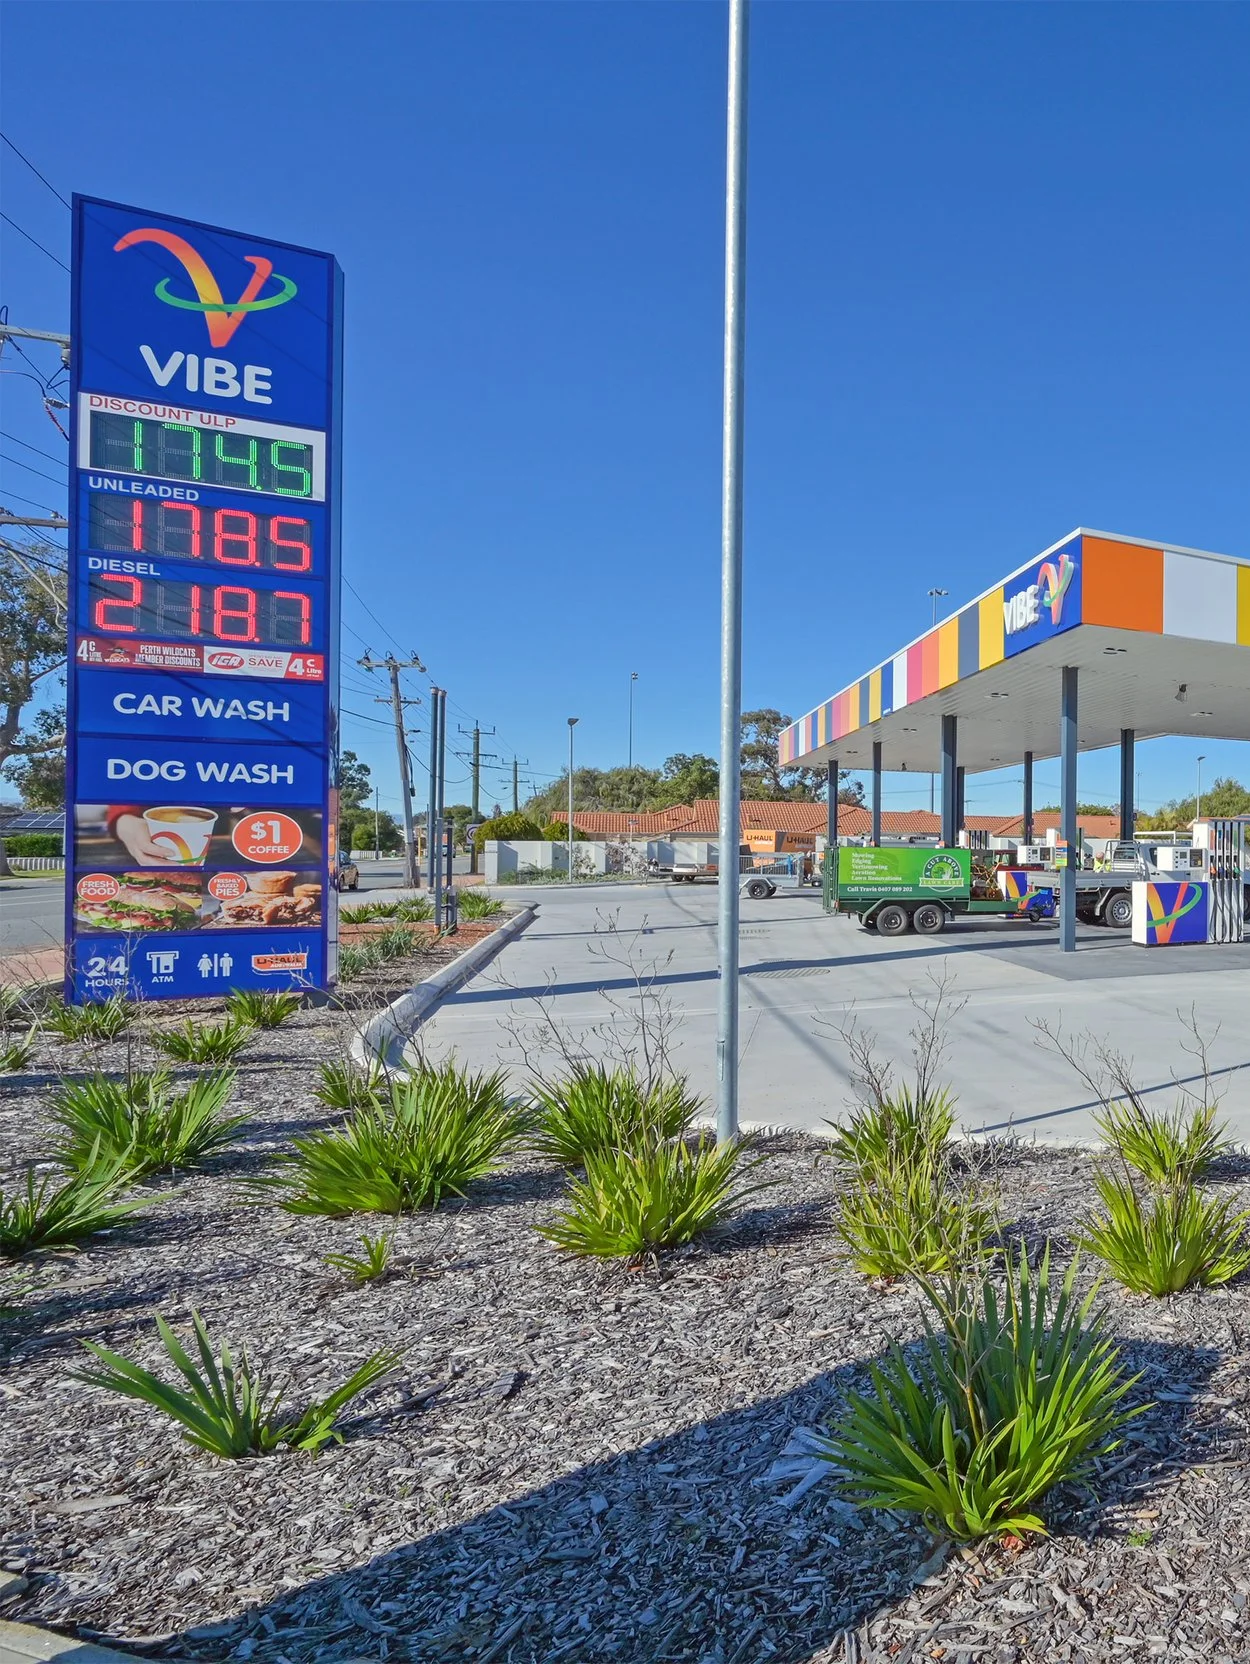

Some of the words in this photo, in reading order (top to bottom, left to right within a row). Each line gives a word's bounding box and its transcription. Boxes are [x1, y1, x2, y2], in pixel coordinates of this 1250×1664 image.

[139, 344, 273, 405] VIBE
[89, 395, 193, 423] DISCOUNT
[200, 411, 237, 429] ULP
[88, 476, 200, 502] UNLEADED
[88, 557, 161, 576] DIESEL
[1003, 584, 1039, 635] VIBE
[77, 640, 88, 662] 4
[135, 653, 164, 664] MEMBER
[165, 656, 201, 667] DISCOUNTS
[140, 645, 161, 655] PERTH
[162, 647, 196, 658] WILDCATS
[211, 655, 241, 667] IGA
[248, 658, 283, 668] SAVE
[288, 658, 305, 676] 4
[113, 692, 182, 717] CAR
[191, 696, 290, 722] WASH
[106, 758, 187, 781] DOG
[196, 761, 294, 785] WASH
[251, 820, 281, 844] $1
[247, 846, 290, 854] COFFEE
[927, 857, 940, 869] CUT
[942, 856, 959, 876] ABOVE
[80, 887, 117, 896] FOOD
[82, 880, 115, 888] FRESH
[215, 887, 240, 896] PIES
[88, 956, 128, 977] 24
[85, 978, 130, 988] HOURS
